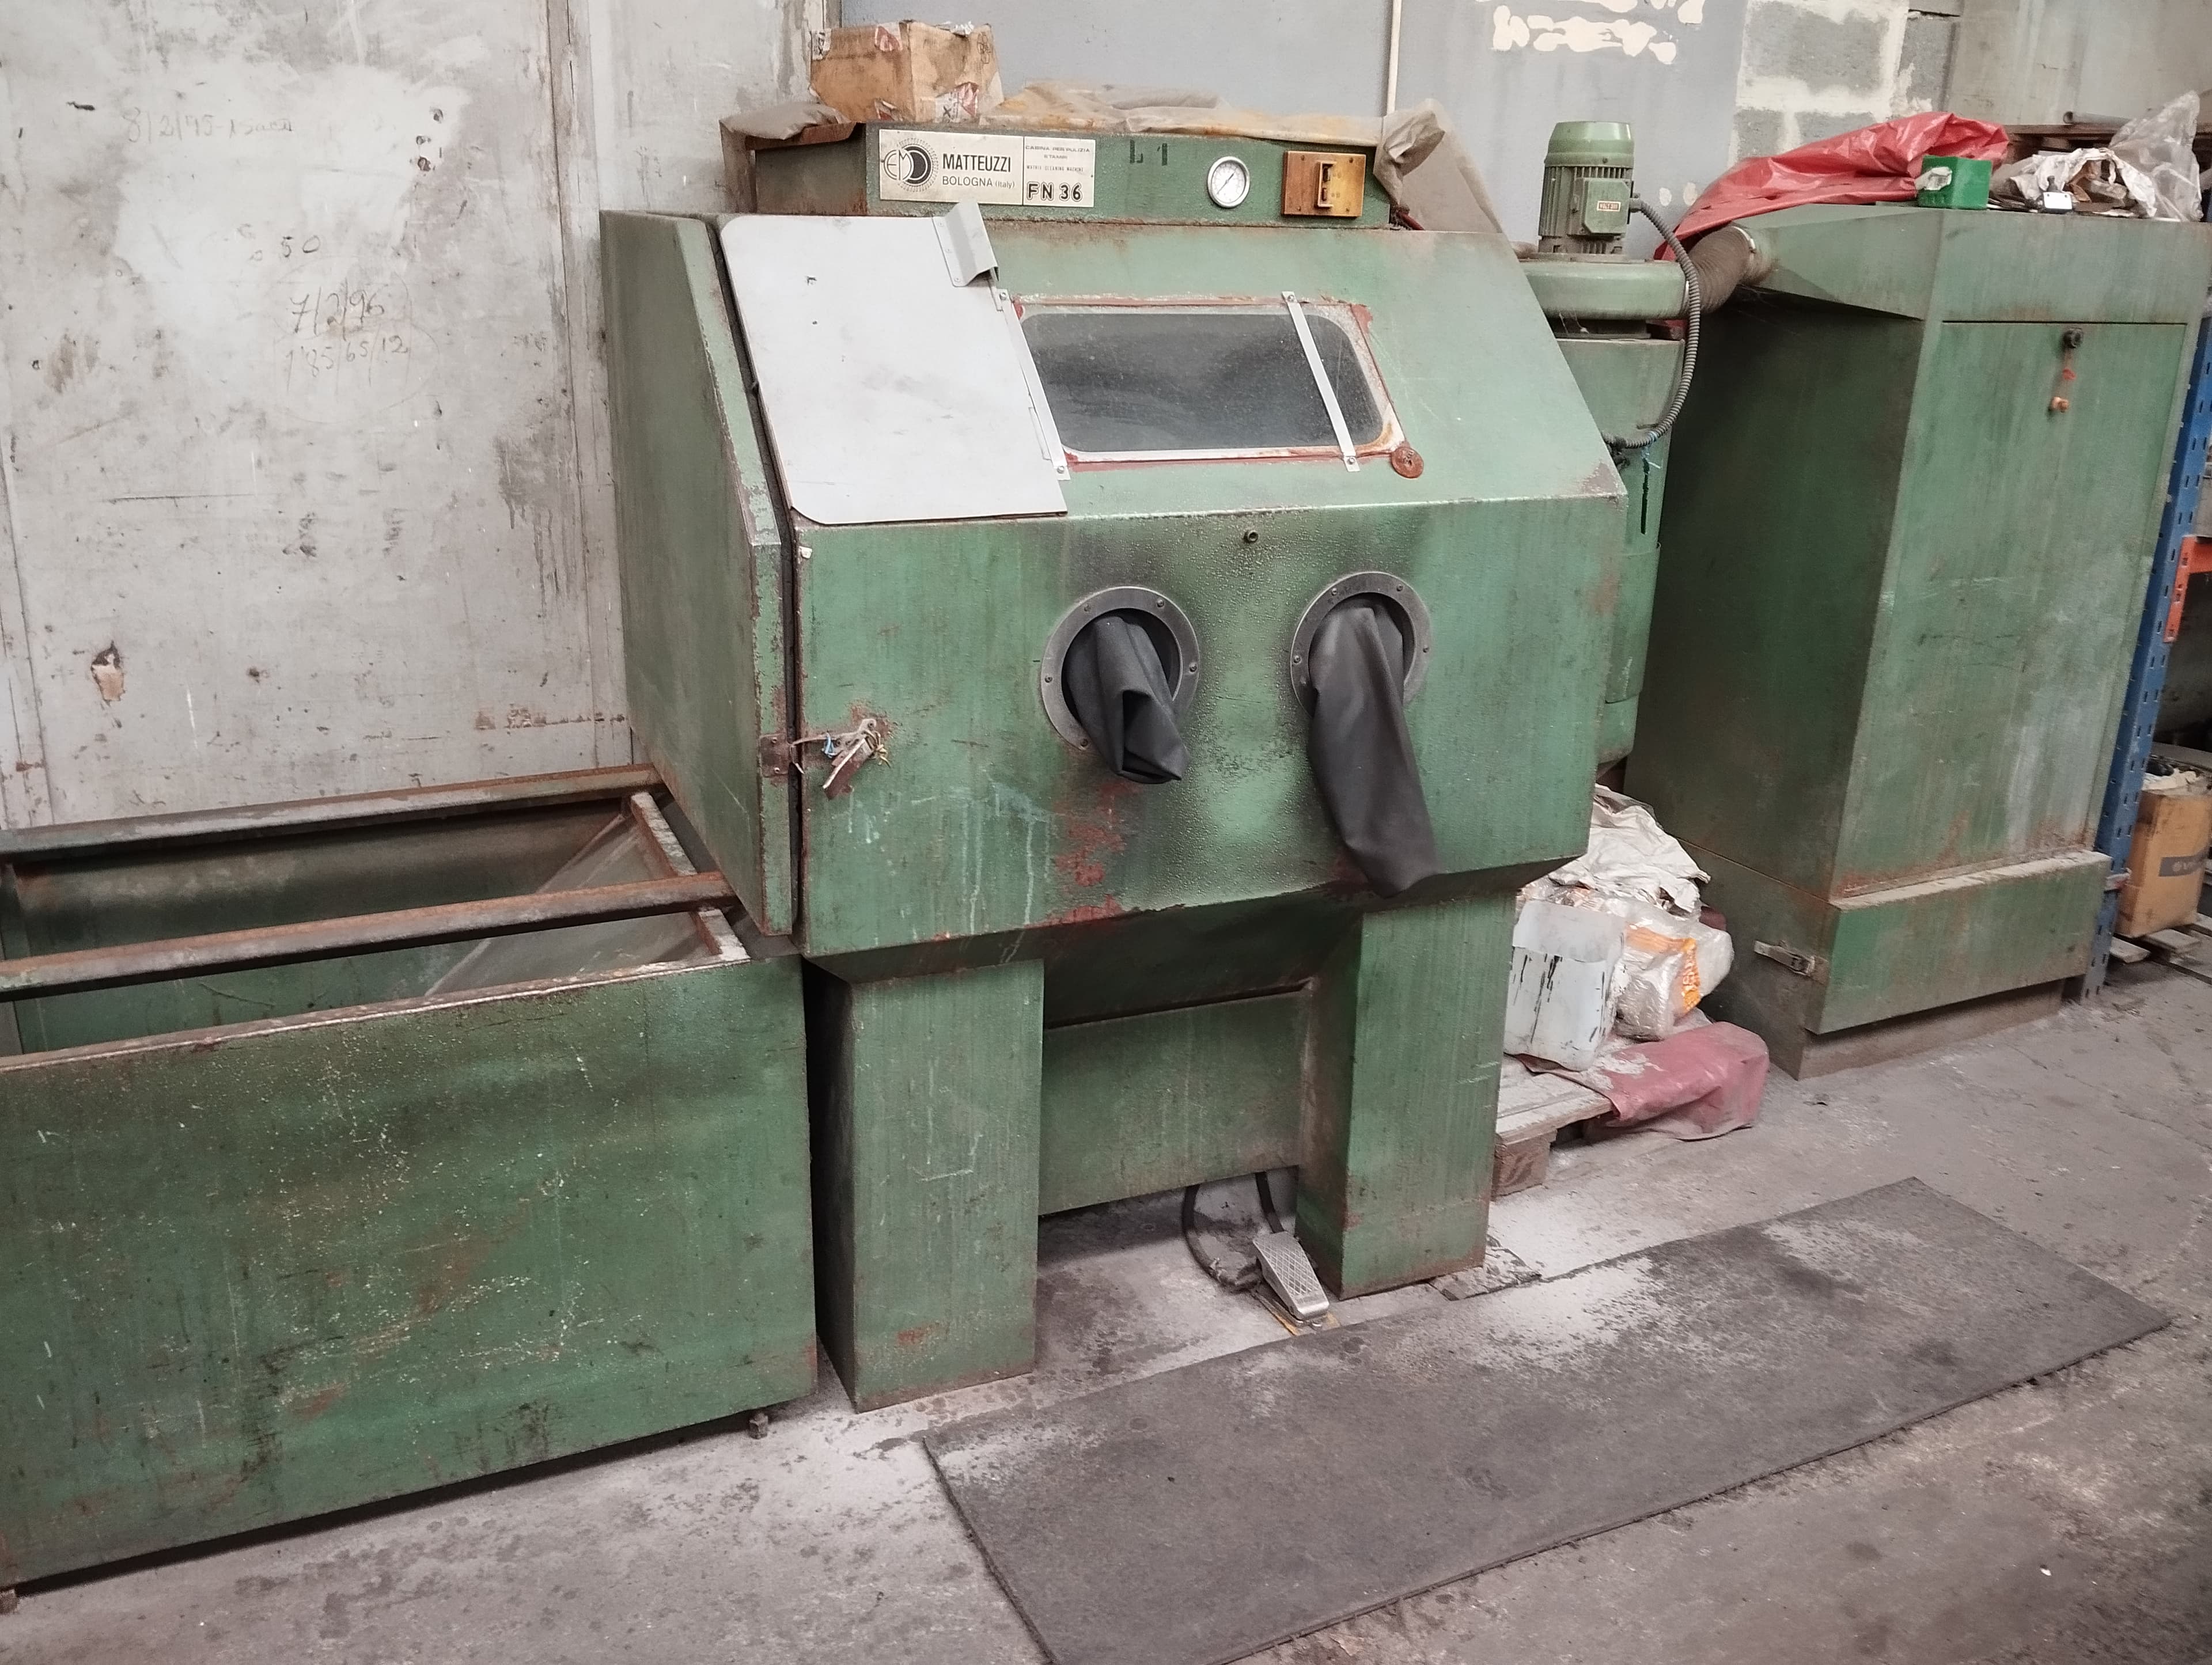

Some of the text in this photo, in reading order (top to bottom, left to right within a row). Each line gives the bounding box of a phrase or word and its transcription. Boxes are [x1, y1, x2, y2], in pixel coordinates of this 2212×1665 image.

[942, 153, 1010, 172] MATTEUZZI
[942, 176, 1015, 189] BOLOGNA (Italy)
[1027, 181, 1083, 202] FN 36
